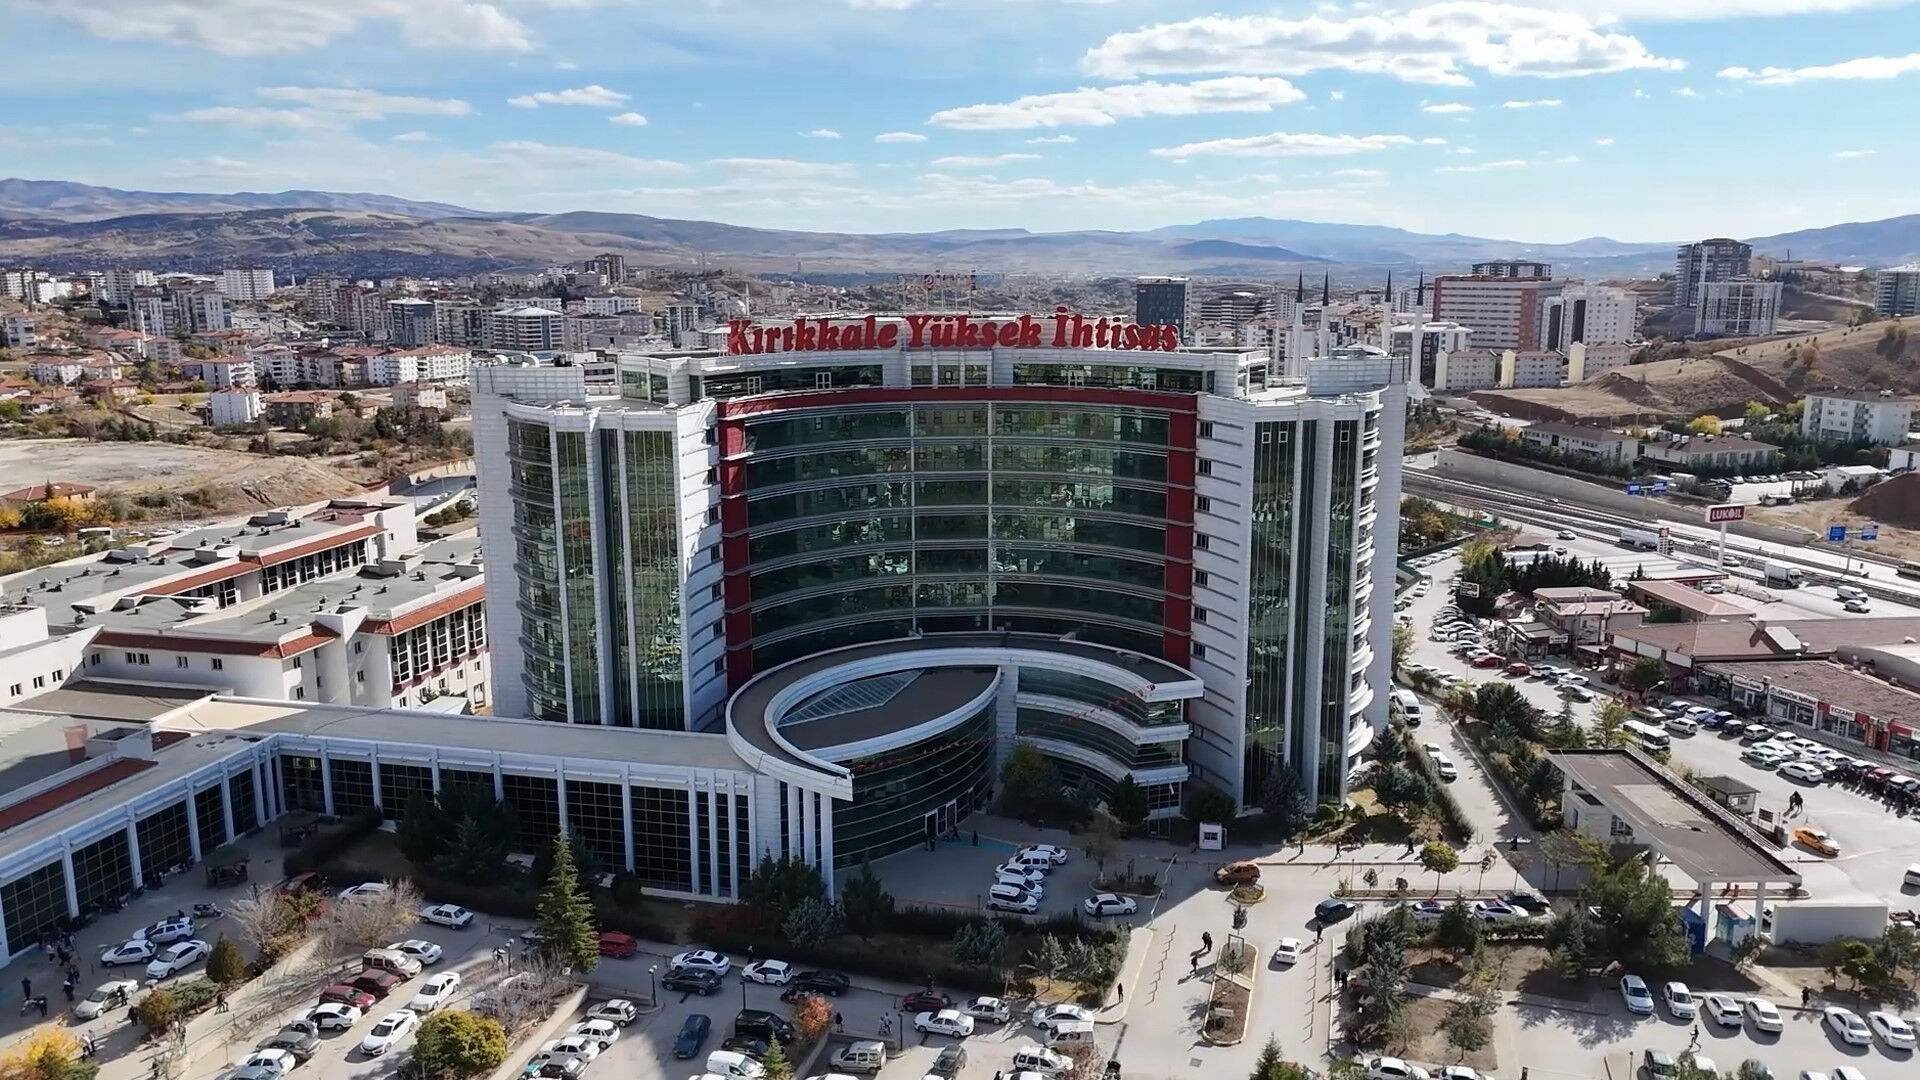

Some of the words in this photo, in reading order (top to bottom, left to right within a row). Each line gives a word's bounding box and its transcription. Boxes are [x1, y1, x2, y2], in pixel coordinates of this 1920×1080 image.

[729, 315, 898, 355] Kırıkkale
[904, 314, 1042, 348] Yüksek
[1052, 306, 1178, 350] İhtisas
[1711, 508, 1742, 520] LUKOIL
